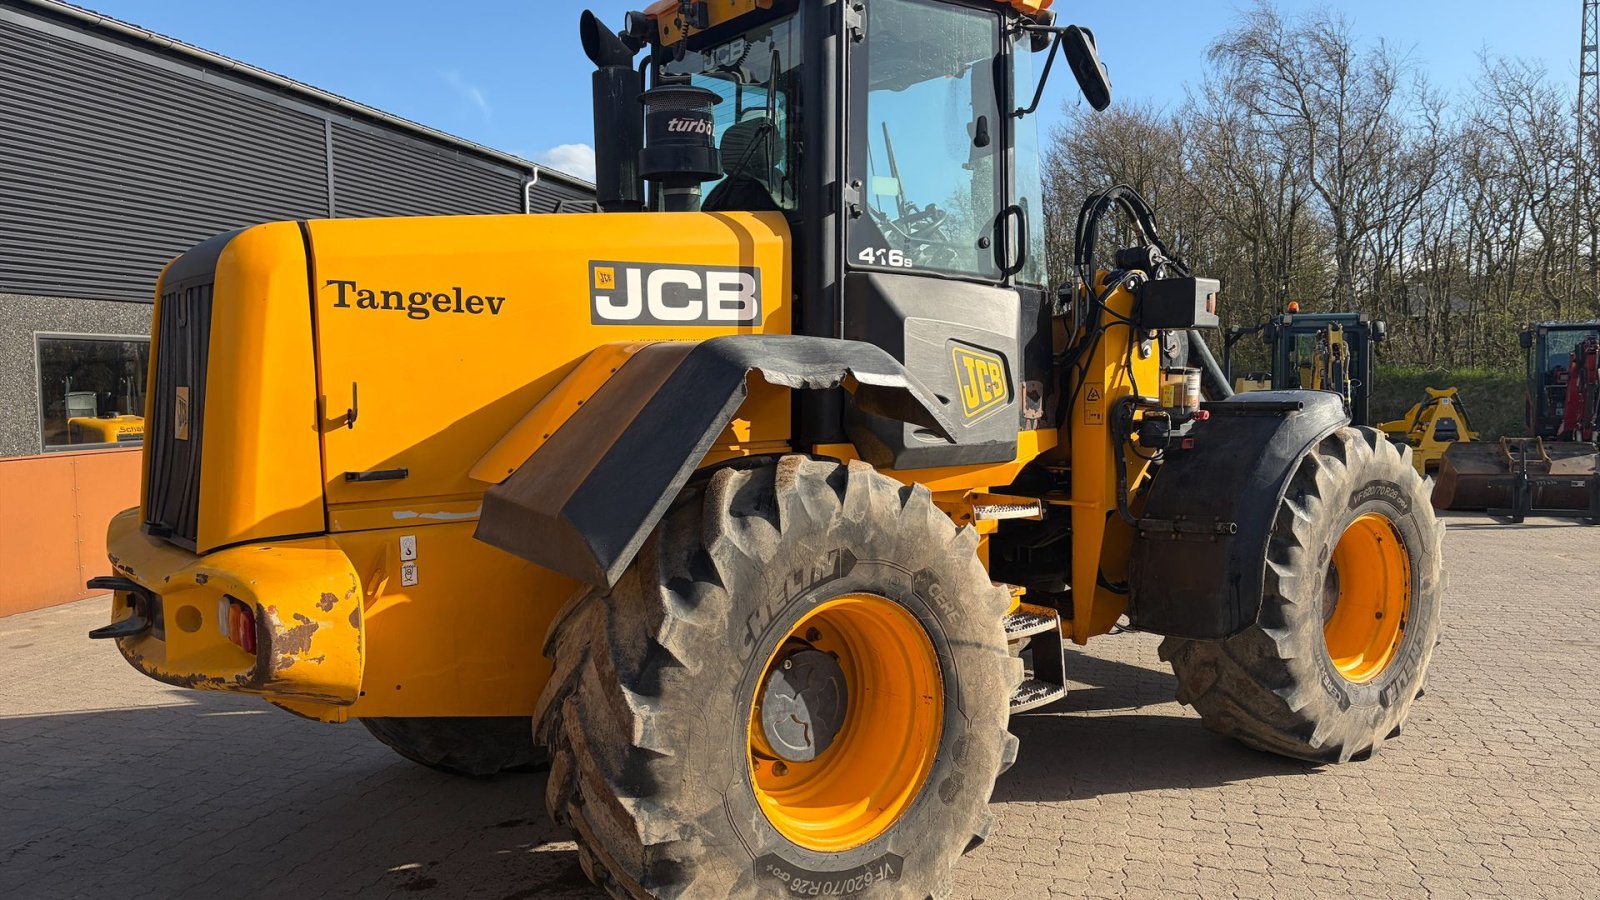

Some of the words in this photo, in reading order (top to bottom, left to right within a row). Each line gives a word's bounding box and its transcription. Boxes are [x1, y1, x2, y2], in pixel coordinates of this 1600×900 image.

[322, 279, 506, 320] Tangelev
[596, 268, 758, 320] JCB
[963, 356, 1004, 409] JCB
[790, 877, 821, 895] R26
[822, 870, 874, 895] 620/70
[874, 862, 894, 882] VF
